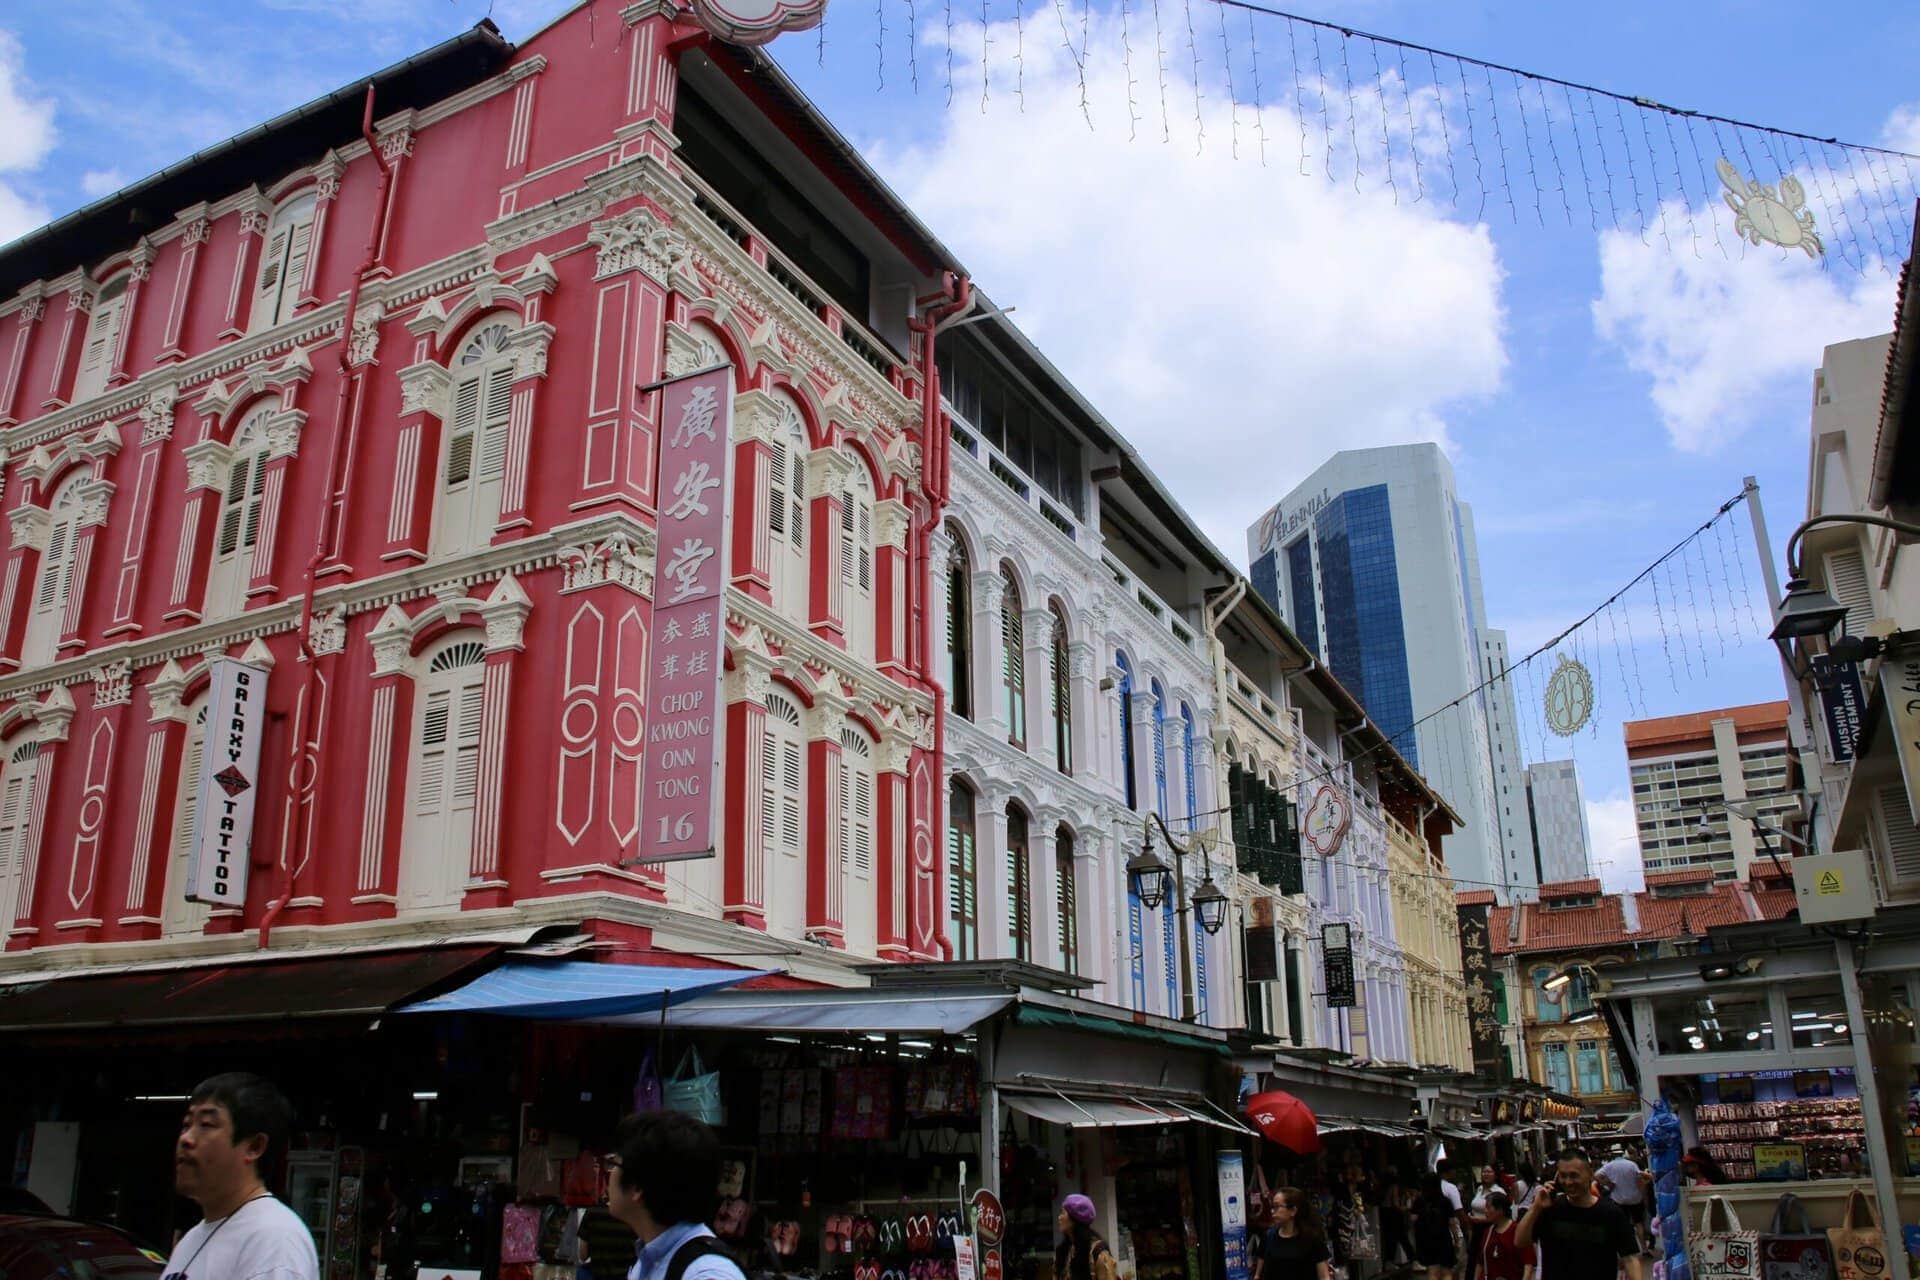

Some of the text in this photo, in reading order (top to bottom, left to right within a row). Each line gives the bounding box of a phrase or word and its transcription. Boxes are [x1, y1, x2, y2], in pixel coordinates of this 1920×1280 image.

[664, 385, 721, 602] 廣安堂
[1257, 487, 1331, 553] PERENNIAL
[228, 671, 249, 763] GALAXY
[661, 690, 703, 714] CHOP
[1841, 683, 1862, 746] OVEMENT
[650, 716, 711, 743] KWONG
[1833, 706, 1853, 754] MUSHIN
[661, 748, 696, 769] ONN
[655, 775, 700, 799] TONG
[214, 799, 238, 897] TATTOO
[655, 810, 695, 844] 16
